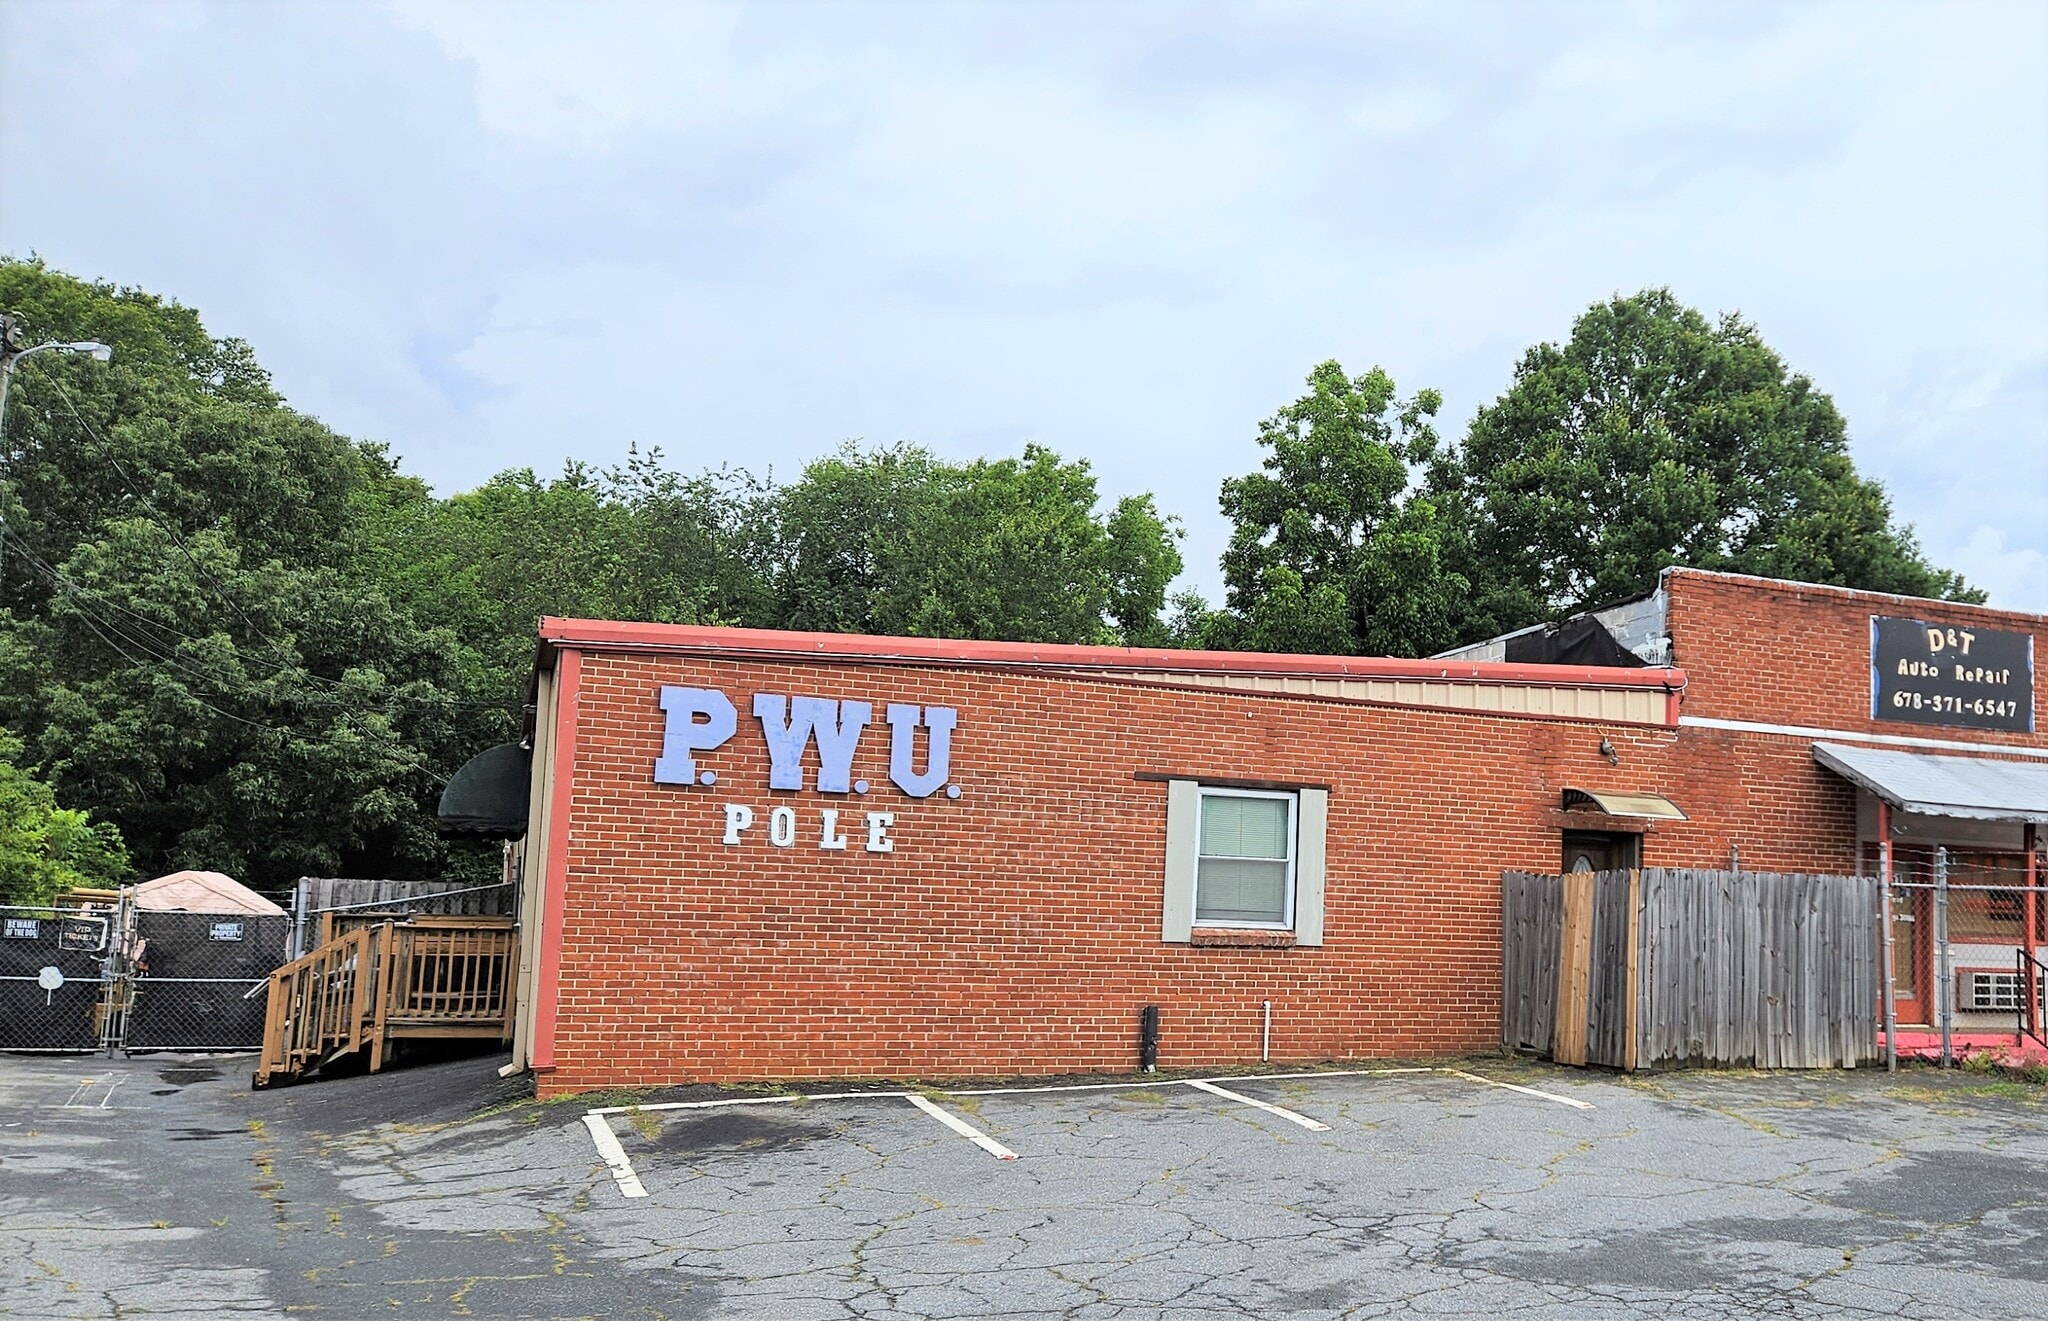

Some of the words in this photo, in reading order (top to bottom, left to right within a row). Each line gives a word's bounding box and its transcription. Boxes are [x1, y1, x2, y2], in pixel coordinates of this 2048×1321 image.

[1927, 627, 1976, 655] D&T
[1893, 690, 2017, 718] 678-371-6547
[722, 803, 896, 852] POLE
[7, 920, 37, 929] BEWARE
[74, 925, 92, 933] VIP
